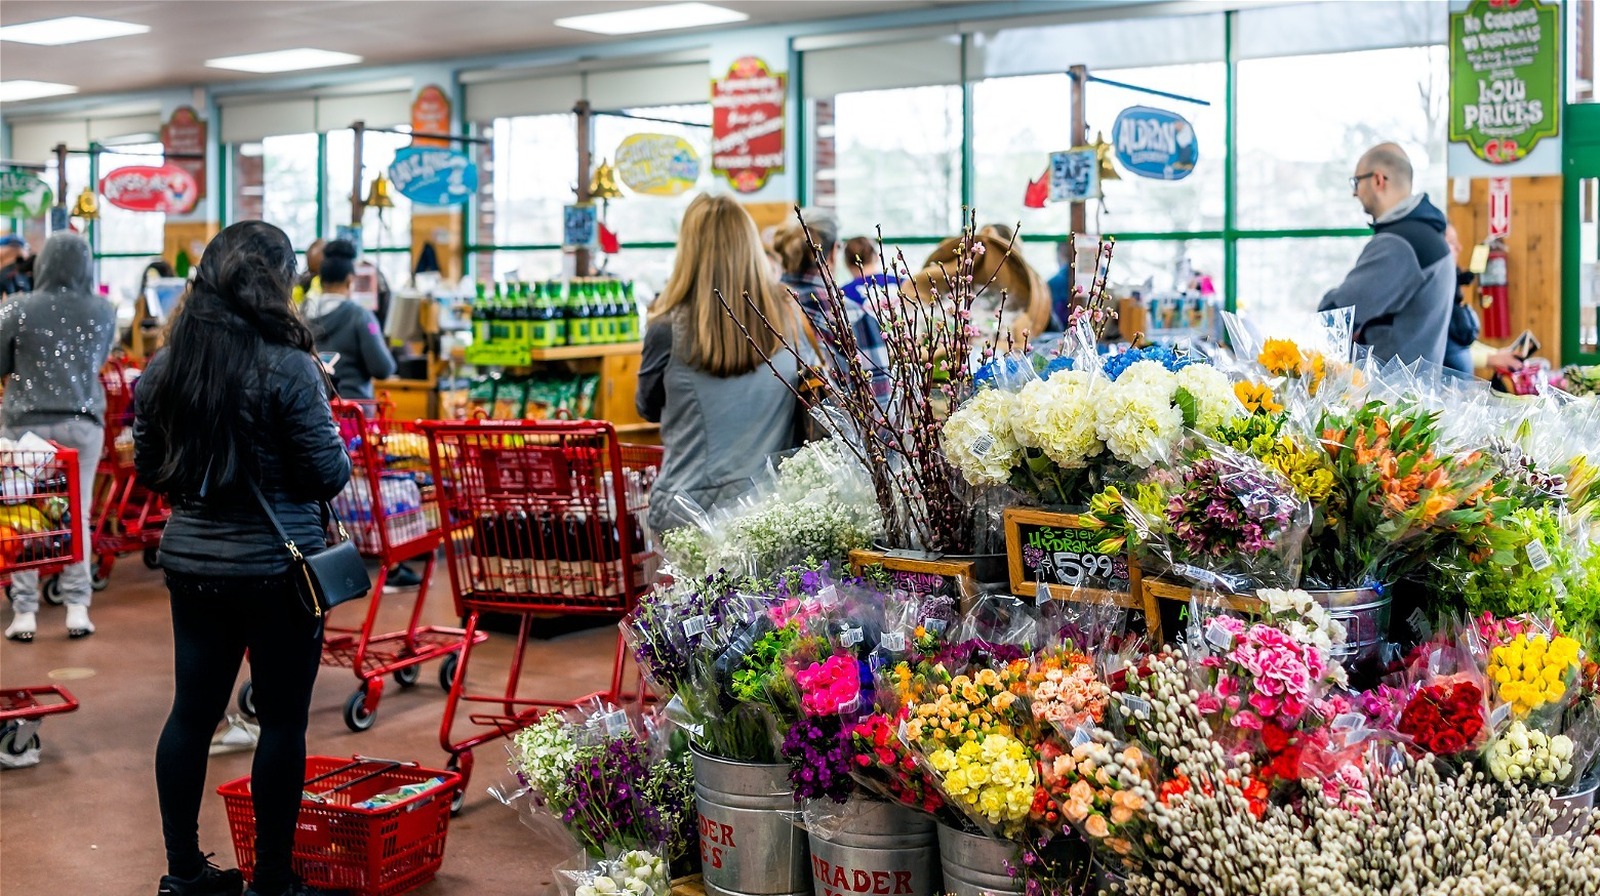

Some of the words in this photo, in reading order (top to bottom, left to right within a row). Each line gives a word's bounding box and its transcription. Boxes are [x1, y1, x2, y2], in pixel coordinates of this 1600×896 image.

[1478, 79, 1525, 102] LOW
[1463, 100, 1543, 130] PRICES
[811, 853, 914, 895] TRADER
